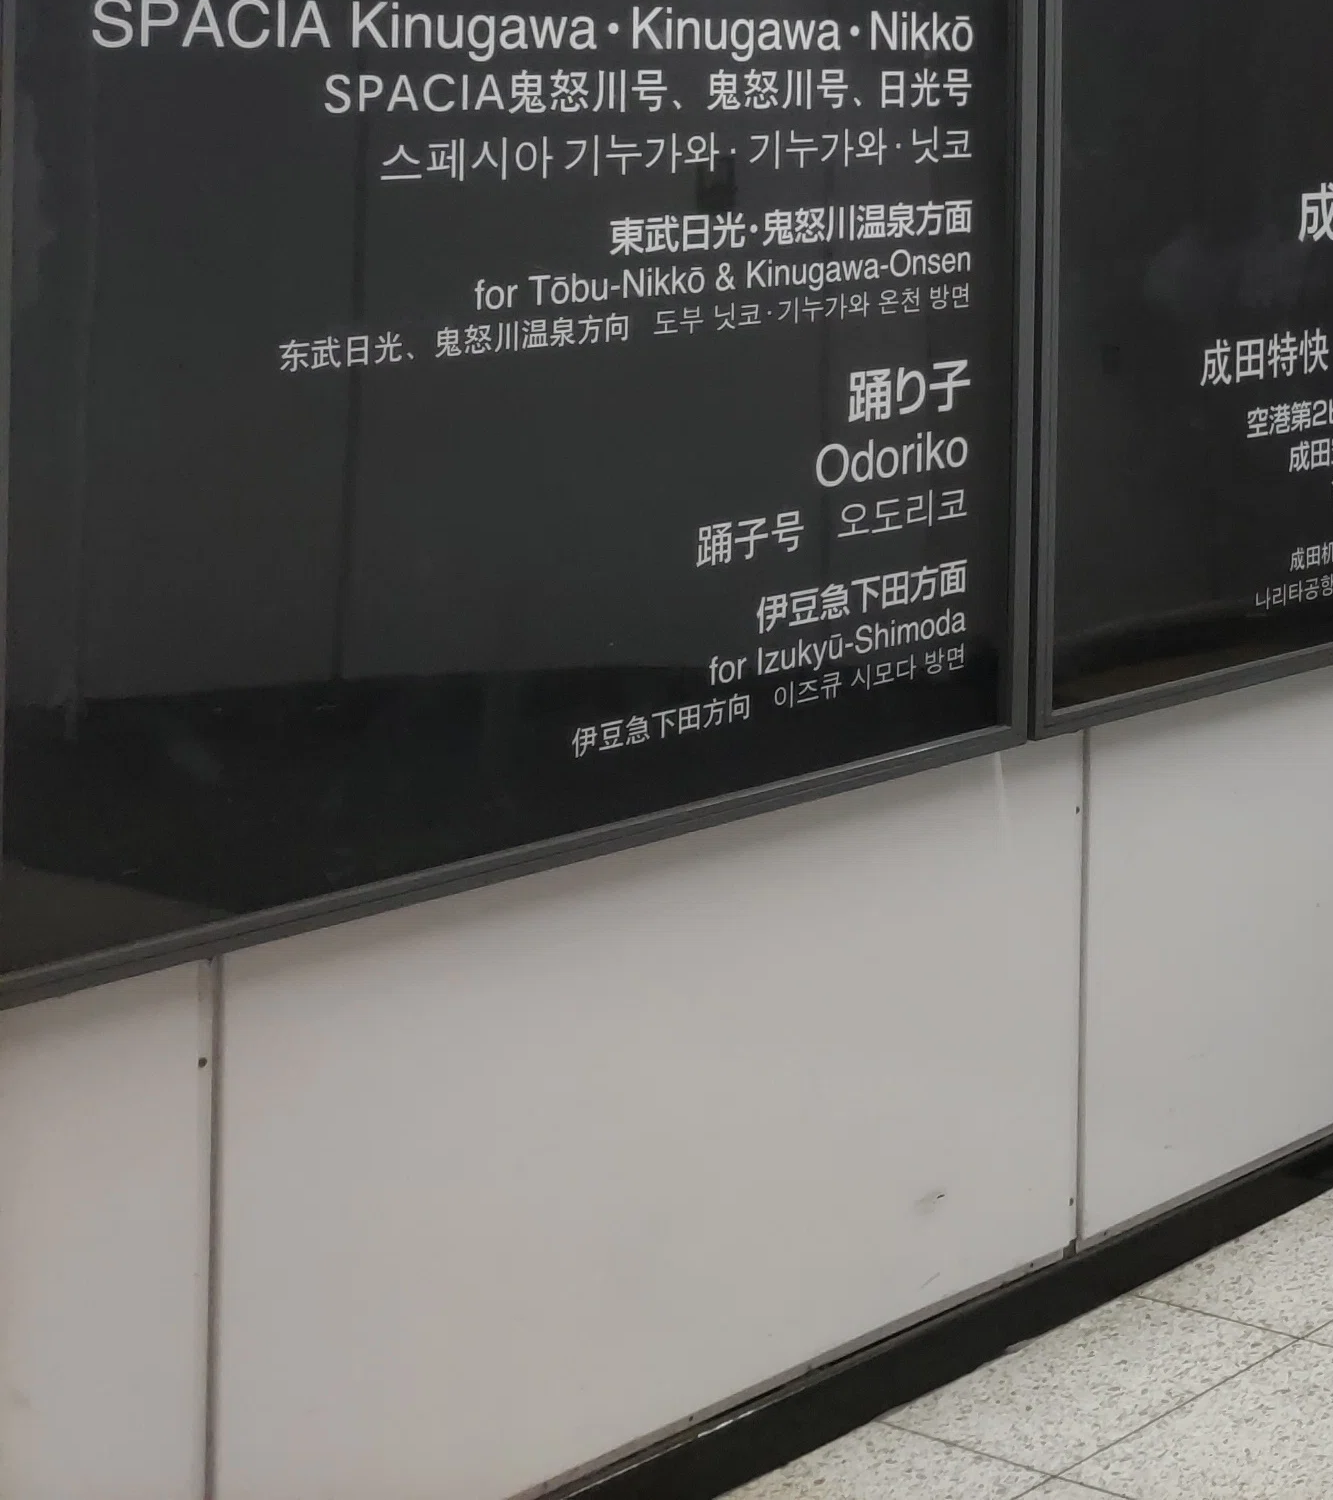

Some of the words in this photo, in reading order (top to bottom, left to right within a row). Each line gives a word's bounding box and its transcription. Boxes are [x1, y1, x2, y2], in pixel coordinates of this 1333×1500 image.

[381, 136, 553, 181] 스페시아
[610, 200, 972, 255] 東武日光・鬼怒川温泉方面
[475, 279, 518, 310] for
[528, 266, 705, 305] Tōbu-Nikkō
[716, 263, 735, 291] &
[747, 249, 970, 291] Kinugawa-Onsen
[279, 313, 628, 372] 东武日光、鬼怒川温泉方向
[654, 307, 703, 334] 도부
[879, 287, 919, 314] 온천
[930, 283, 969, 309] 방면
[1200, 328, 1329, 386] 成田特快
[848, 360, 970, 422] 踊り子
[816, 432, 967, 487] Odoriko
[696, 511, 804, 567] 踊子号
[838, 489, 967, 537] 오도리코
[757, 560, 967, 634] 伊豆急下田方面
[709, 656, 747, 685] for
[758, 608, 966, 675] Izukyū-Shimoda
[572, 695, 749, 758] 伊豆急下田方向
[775, 672, 842, 708] 이즈큐
[851, 654, 917, 690] 시모다
[925, 643, 964, 674] 방면
